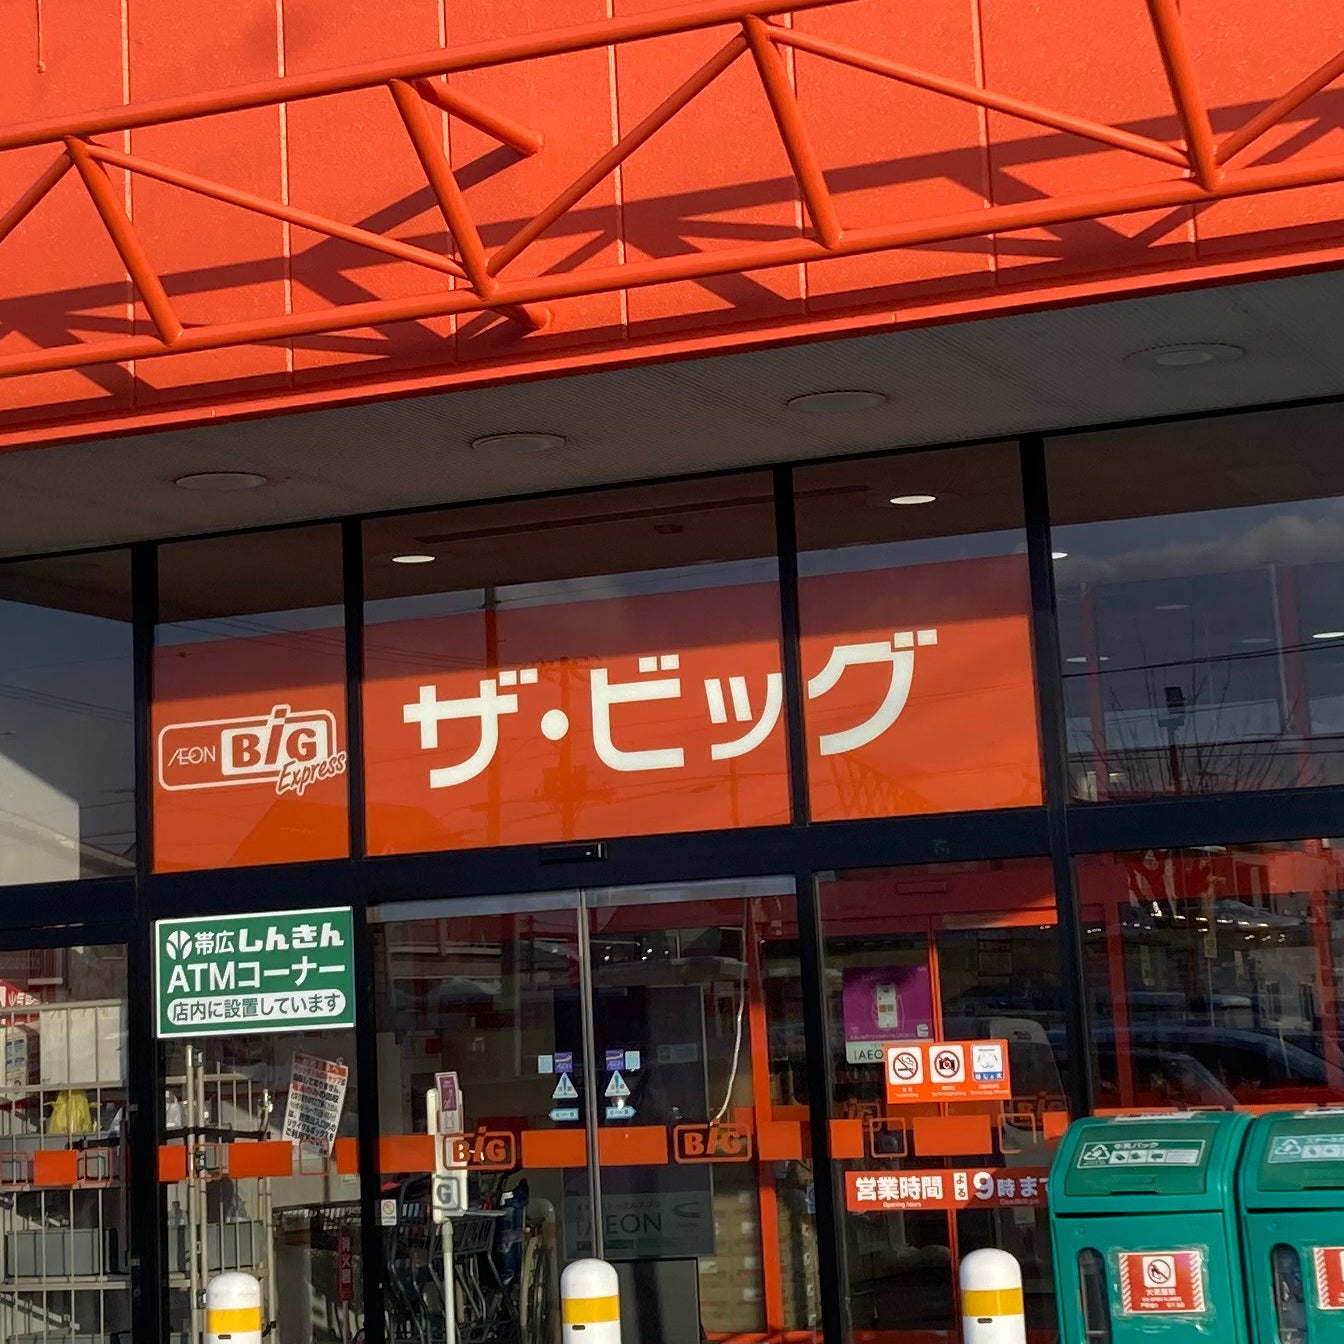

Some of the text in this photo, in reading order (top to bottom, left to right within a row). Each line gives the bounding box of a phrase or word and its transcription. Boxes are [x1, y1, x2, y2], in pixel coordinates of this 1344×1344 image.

[403, 629, 937, 789] ザ・ビッグ
[277, 751, 347, 795] Express
[166, 955, 346, 994] ATMコーナー
[172, 992, 341, 1022] 店内に設置しています
[856, 1175, 944, 1201] 営業時間
